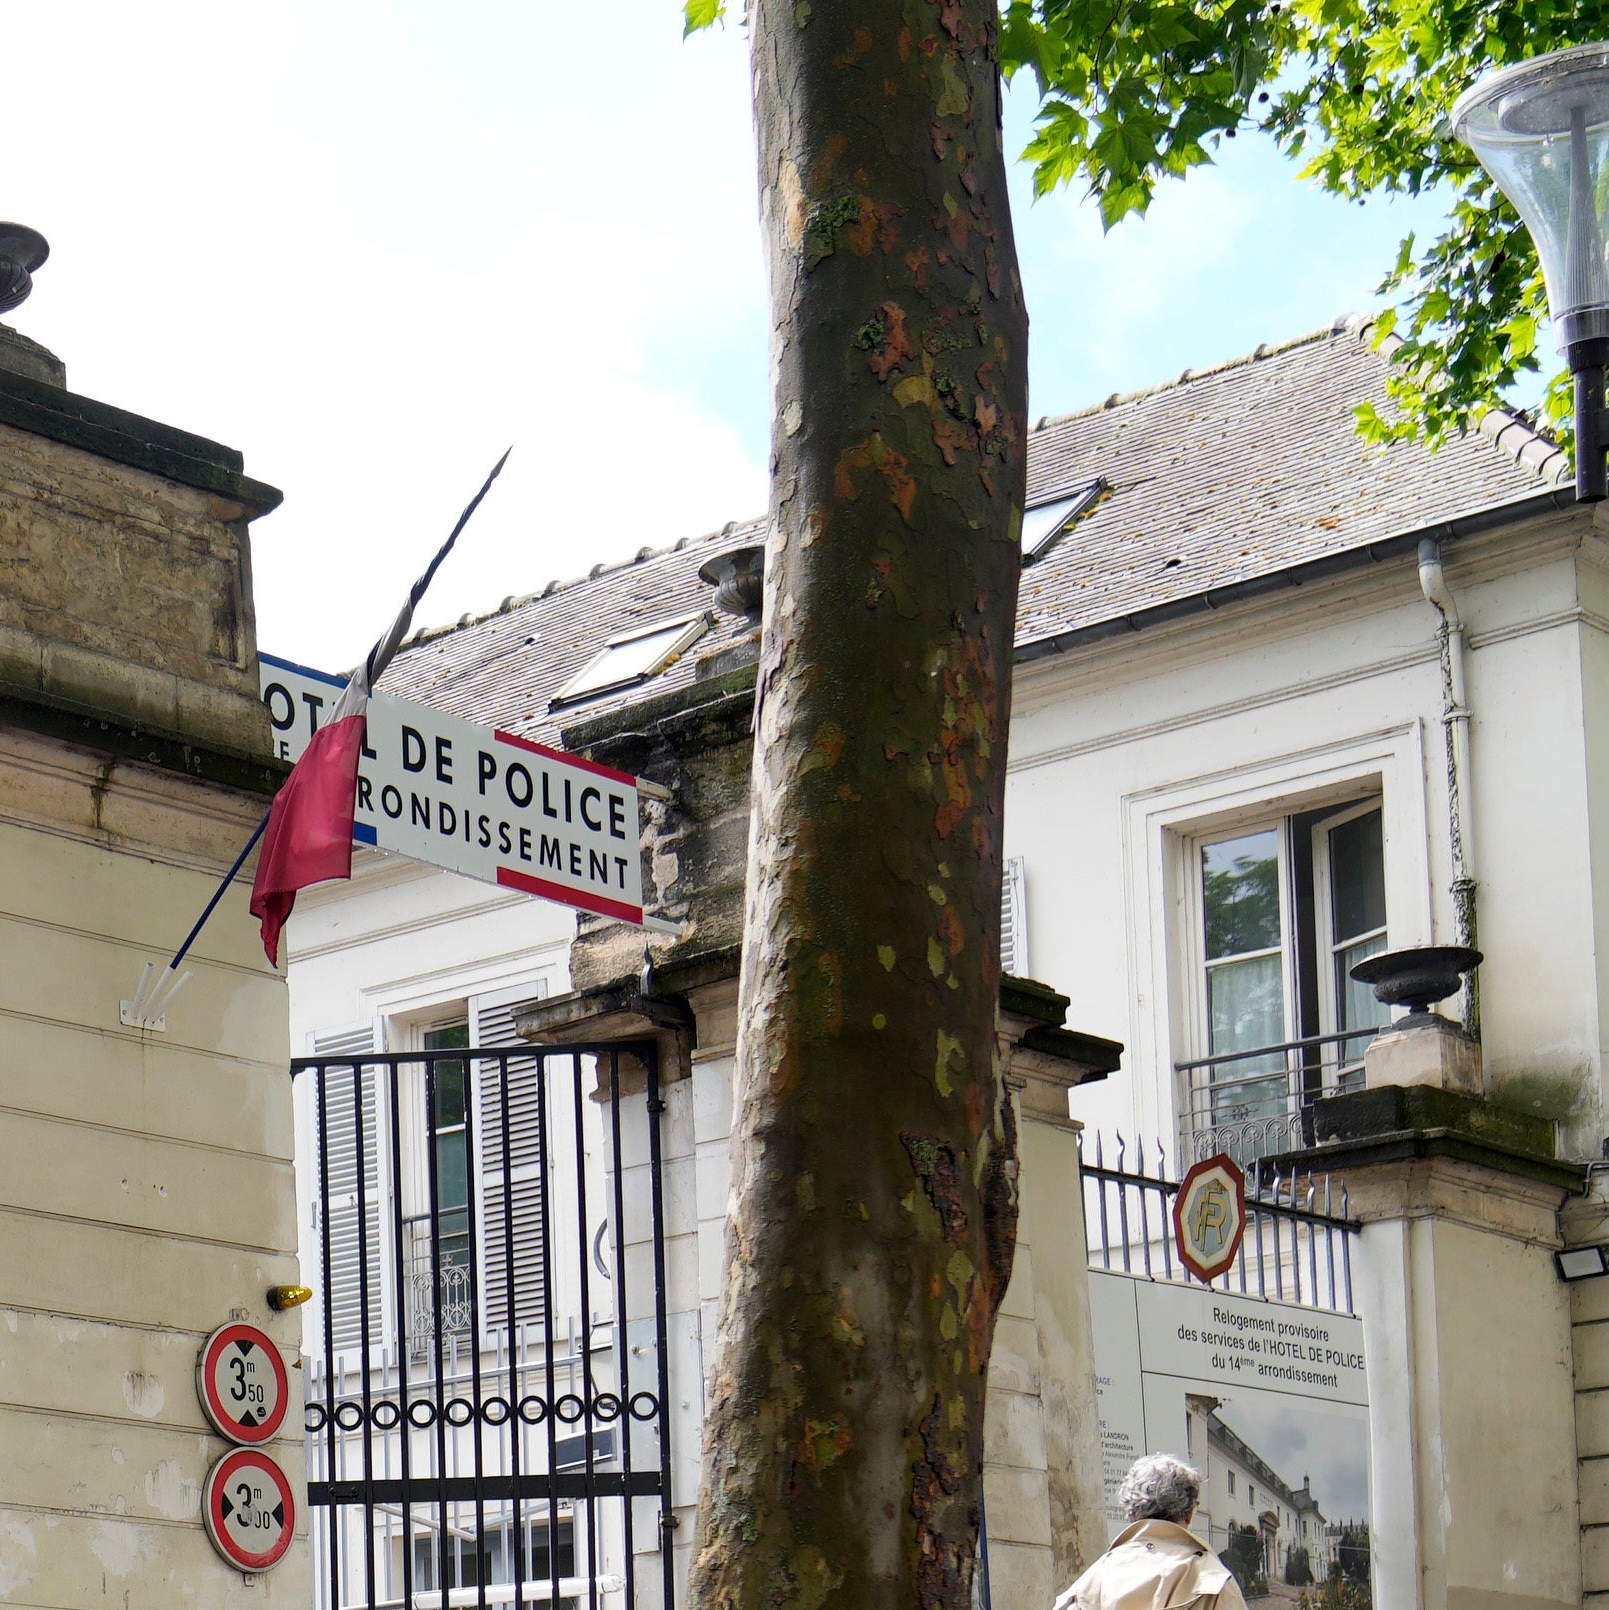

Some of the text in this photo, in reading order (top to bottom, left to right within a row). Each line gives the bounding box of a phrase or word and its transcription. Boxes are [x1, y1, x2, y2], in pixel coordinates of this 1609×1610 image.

[263, 682, 626, 840] OTL DE POLICE
[357, 774, 628, 889] RONDISSEMENT
[1177, 1323, 1365, 1370] des services de l'HOTEL DE POLICE
[1213, 1307, 1329, 1342] Relogement provisoire
[1211, 1353, 1225, 1369] du
[1258, 1363, 1338, 1388] arrondissement
